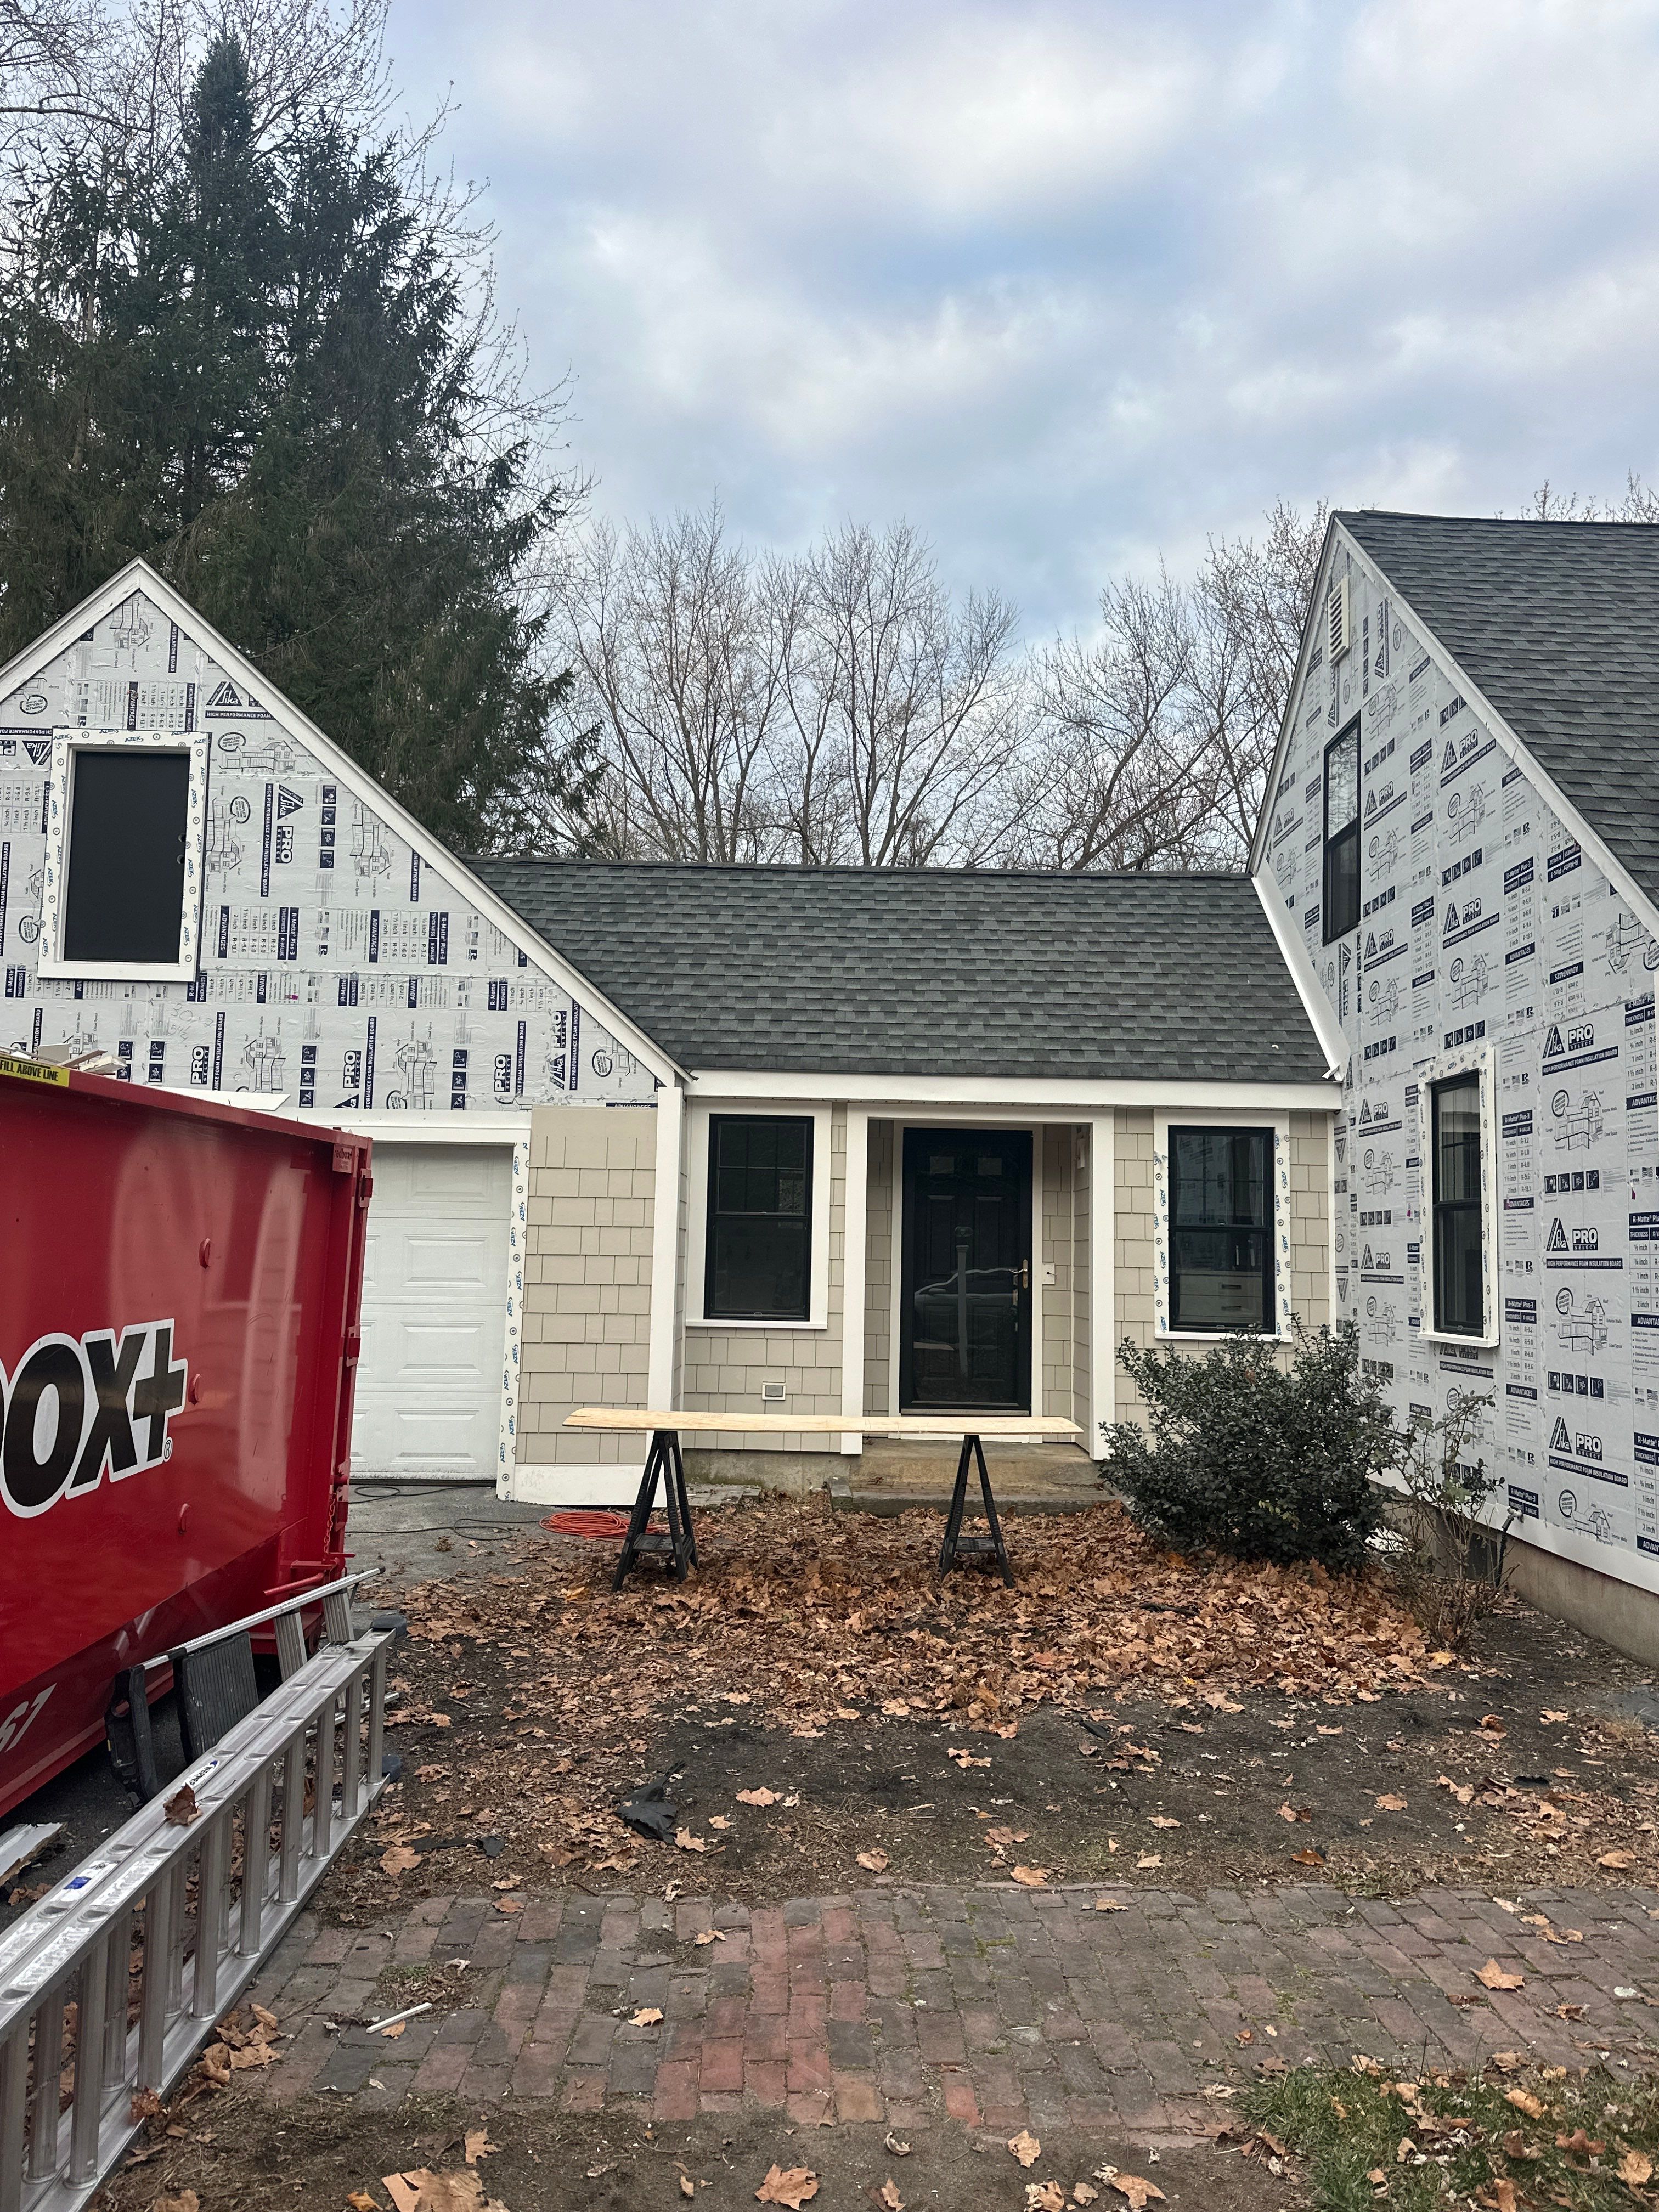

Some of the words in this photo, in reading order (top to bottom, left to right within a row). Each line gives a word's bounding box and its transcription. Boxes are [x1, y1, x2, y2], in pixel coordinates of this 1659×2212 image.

[218, 690, 239, 704] Sika
[26, 743, 46, 757] Sika
[1460, 729, 1478, 753] PRO
[1379, 781, 1393, 801] PRO
[280, 795, 295, 816] Sika
[281, 826, 293, 862] PRO
[1463, 898, 1481, 918] PRO
[1380, 929, 1394, 946] PRO
[1626, 1013, 1644, 1023] THICKNESS
[551, 1011, 562, 1047] PRO
[1568, 1025, 1593, 1044] PRO
[1549, 1034, 1562, 1054] Sika
[1570, 1041, 1592, 1050] SELECT
[191, 1047, 204, 1084] PRO
[1551, 1062, 1575, 1071] PERFORMANCE
[1584, 1054, 1605, 1064] INSULATION
[1605, 1048, 1617, 1057] BOARD
[0, 1061, 14, 1073] FILL
[17, 1065, 41, 1078] ABOVE
[43, 1069, 59, 1081] LINE
[343, 1051, 356, 1088] PRO
[495, 1055, 506, 1091] PRO
[1374, 1102, 1389, 1116] PRO
[1519, 1111, 1530, 1121] Plus-3
[1554, 1229, 1566, 1248] Sika
[1573, 1229, 1598, 1243] PRO
[1376, 1253, 1391, 1265] PRO
[1510, 1386, 1533, 1397] ADVANTAGES
[0, 1323, 185, 1512] OX+
[1556, 1429, 1569, 1449] Sika
[1577, 1434, 1601, 1453] PRO
[1635, 1451, 1654, 1462] THICKNESS
[1592, 1469, 1613, 1480] INSULATION
[1615, 1475, 1627, 1484] BOARD
